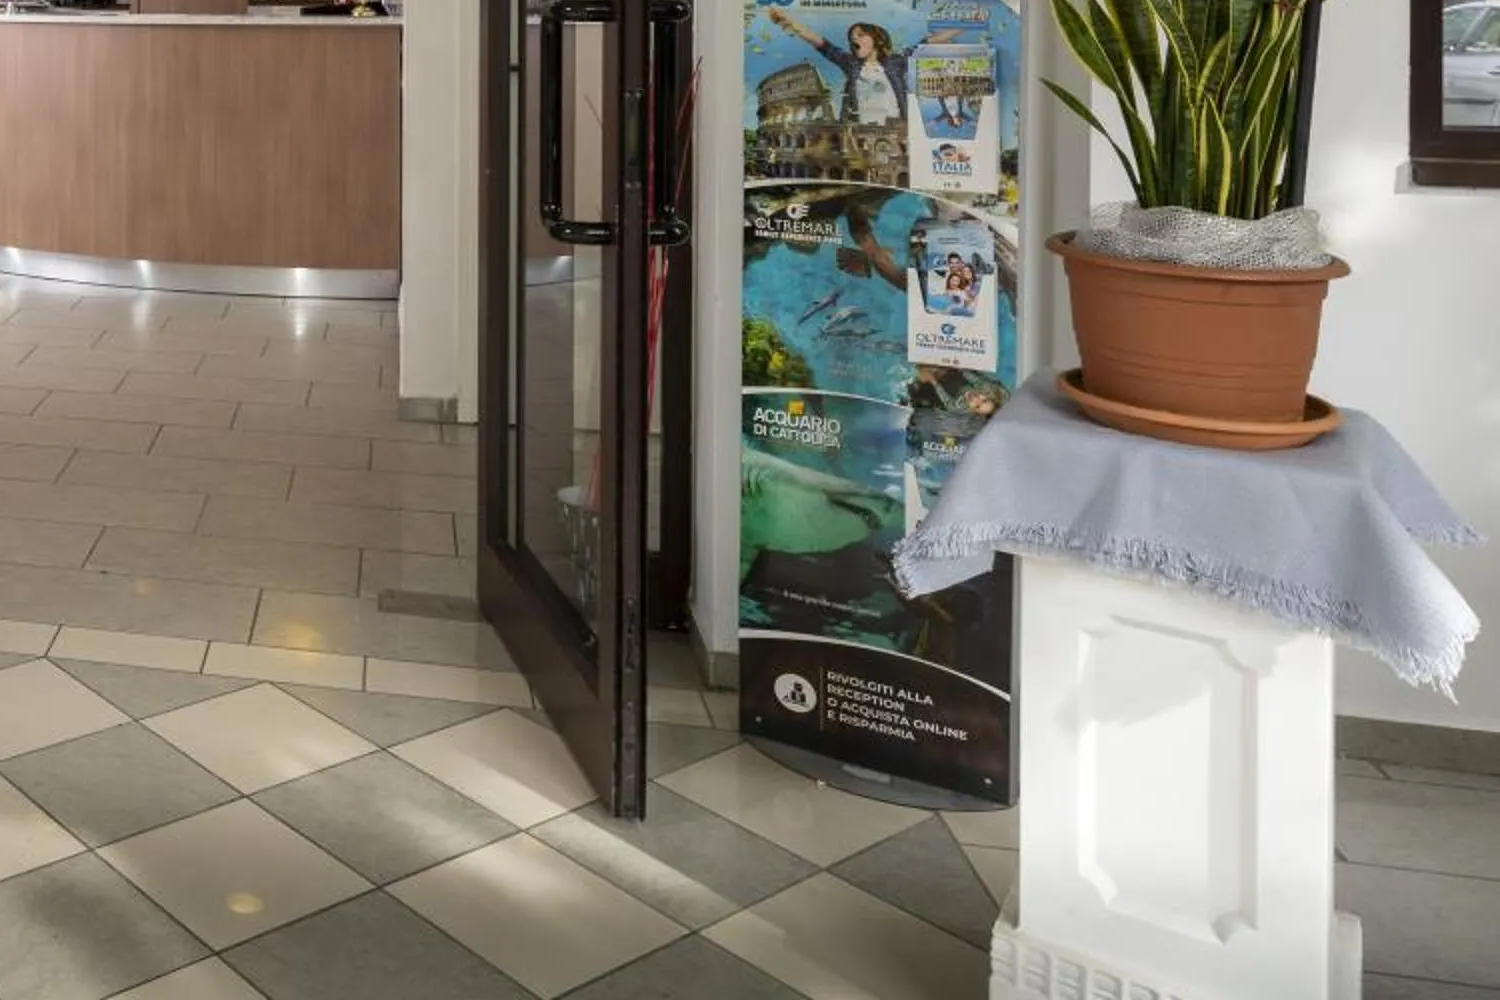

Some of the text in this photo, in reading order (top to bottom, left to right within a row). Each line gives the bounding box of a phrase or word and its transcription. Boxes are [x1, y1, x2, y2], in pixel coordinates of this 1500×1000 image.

[755, 217, 842, 237] OLTREMARE
[753, 407, 841, 435] ACQUARIO
[753, 423, 767, 437] DI
[827, 683, 905, 712] RECEPTION
[897, 689, 934, 706] ALLA
[827, 697, 968, 741] O ACQUISTA ONLINE
[827, 709, 916, 741] E RISPARMIA
